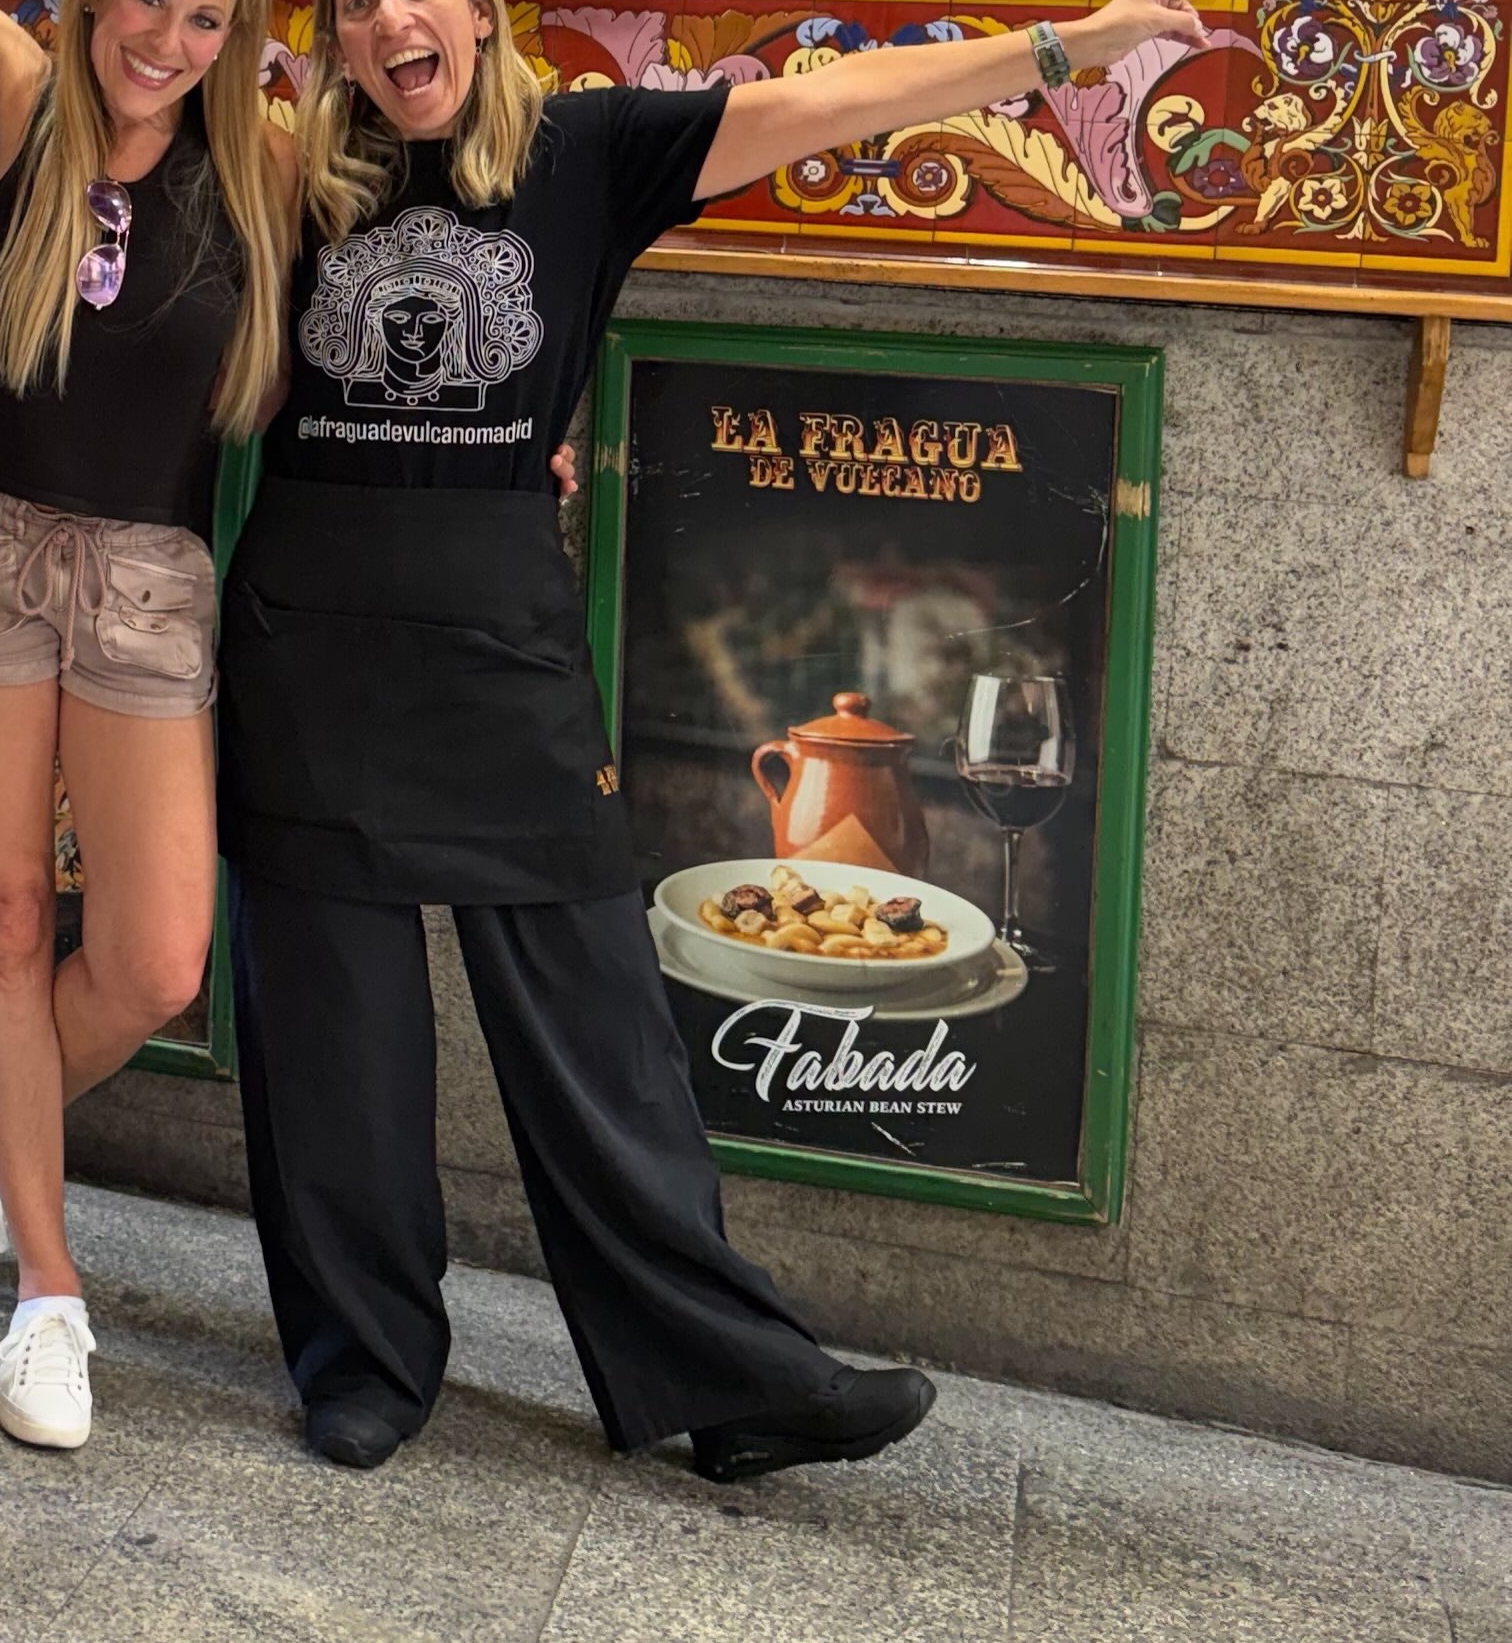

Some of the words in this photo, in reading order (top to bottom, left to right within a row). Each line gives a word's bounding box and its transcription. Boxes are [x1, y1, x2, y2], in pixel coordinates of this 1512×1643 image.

[710, 405, 782, 455] LA
[799, 412, 1024, 473] FRAGUA
[749, 456, 795, 490] DE
[807, 458, 982, 504] VULCANO
[711, 998, 977, 1103] Fabada
[782, 1098, 865, 1113] ASTURIAN
[869, 1100, 913, 1114] BEAN
[916, 1101, 963, 1116] STEW
